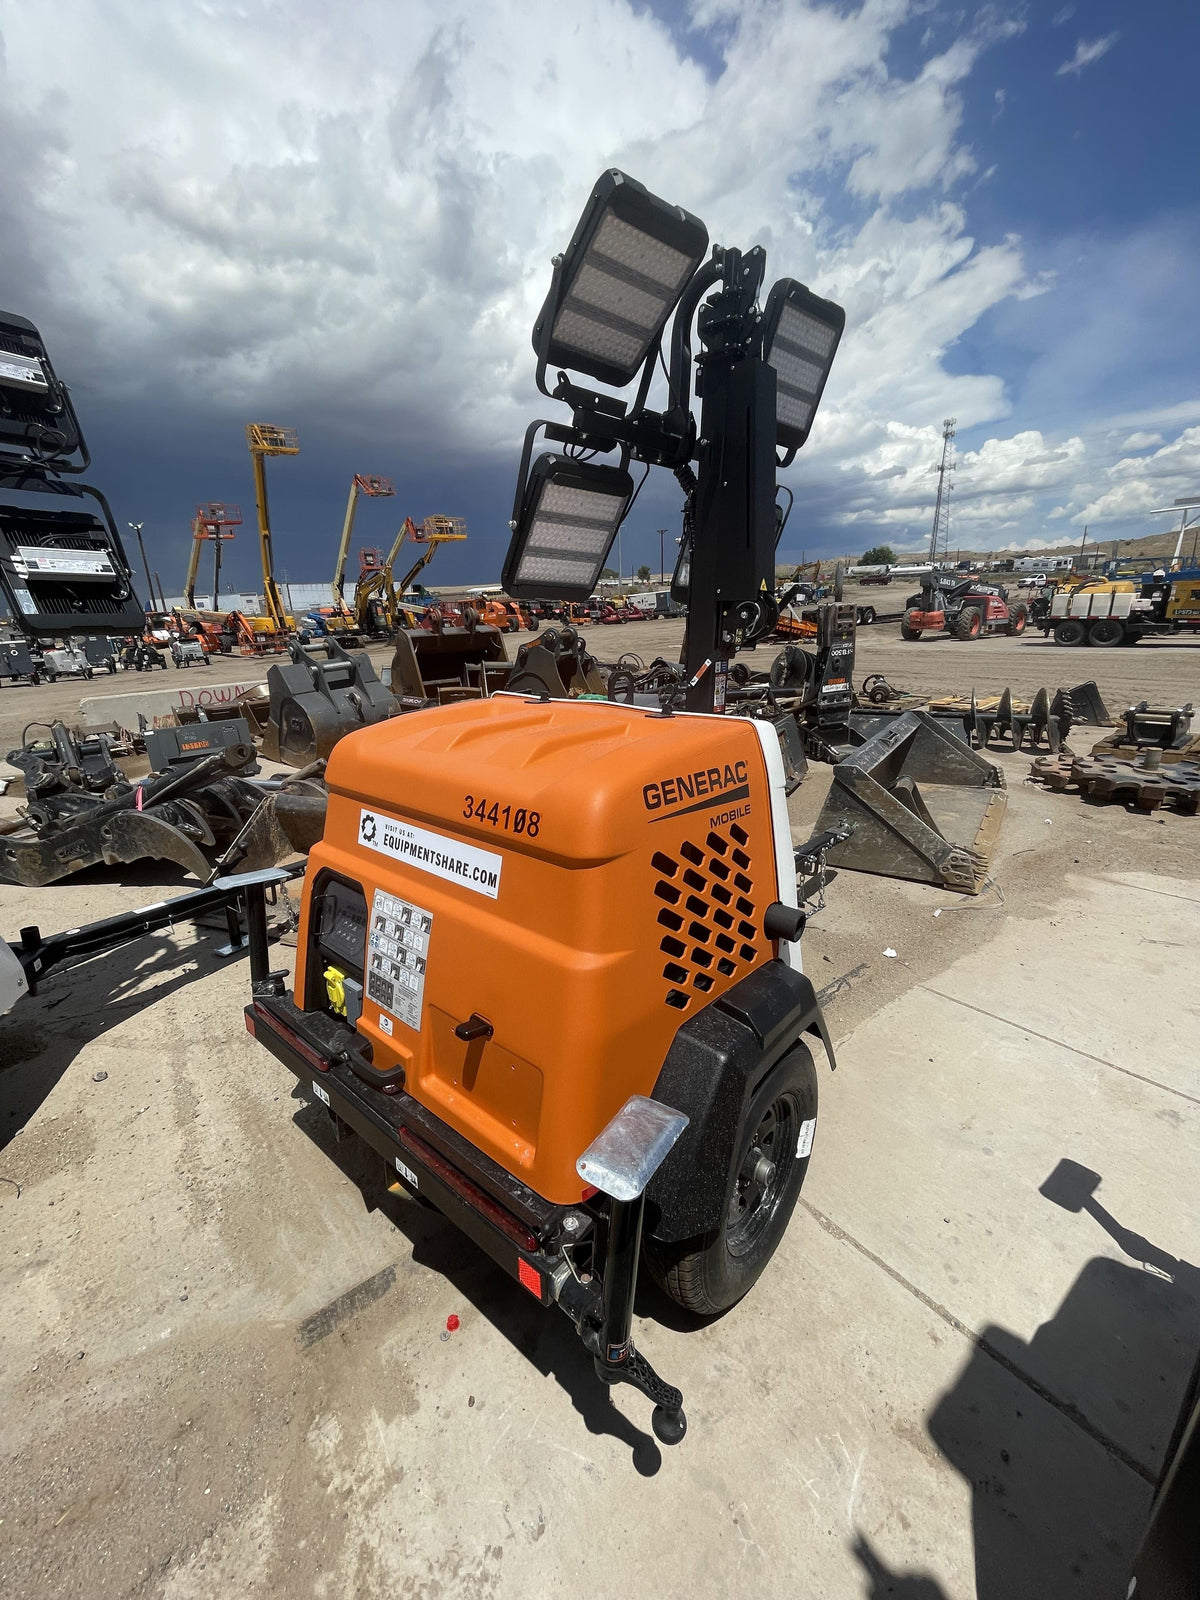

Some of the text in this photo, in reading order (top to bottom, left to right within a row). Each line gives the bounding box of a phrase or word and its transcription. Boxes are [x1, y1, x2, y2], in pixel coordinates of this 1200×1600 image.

[642, 760, 748, 810] GENERAC
[384, 824, 415, 839] VISIT US AT:
[462, 795, 541, 838] 344108
[709, 804, 751, 829] MOBILE
[383, 833, 498, 889] EQUIPMENTSHARE.COM
